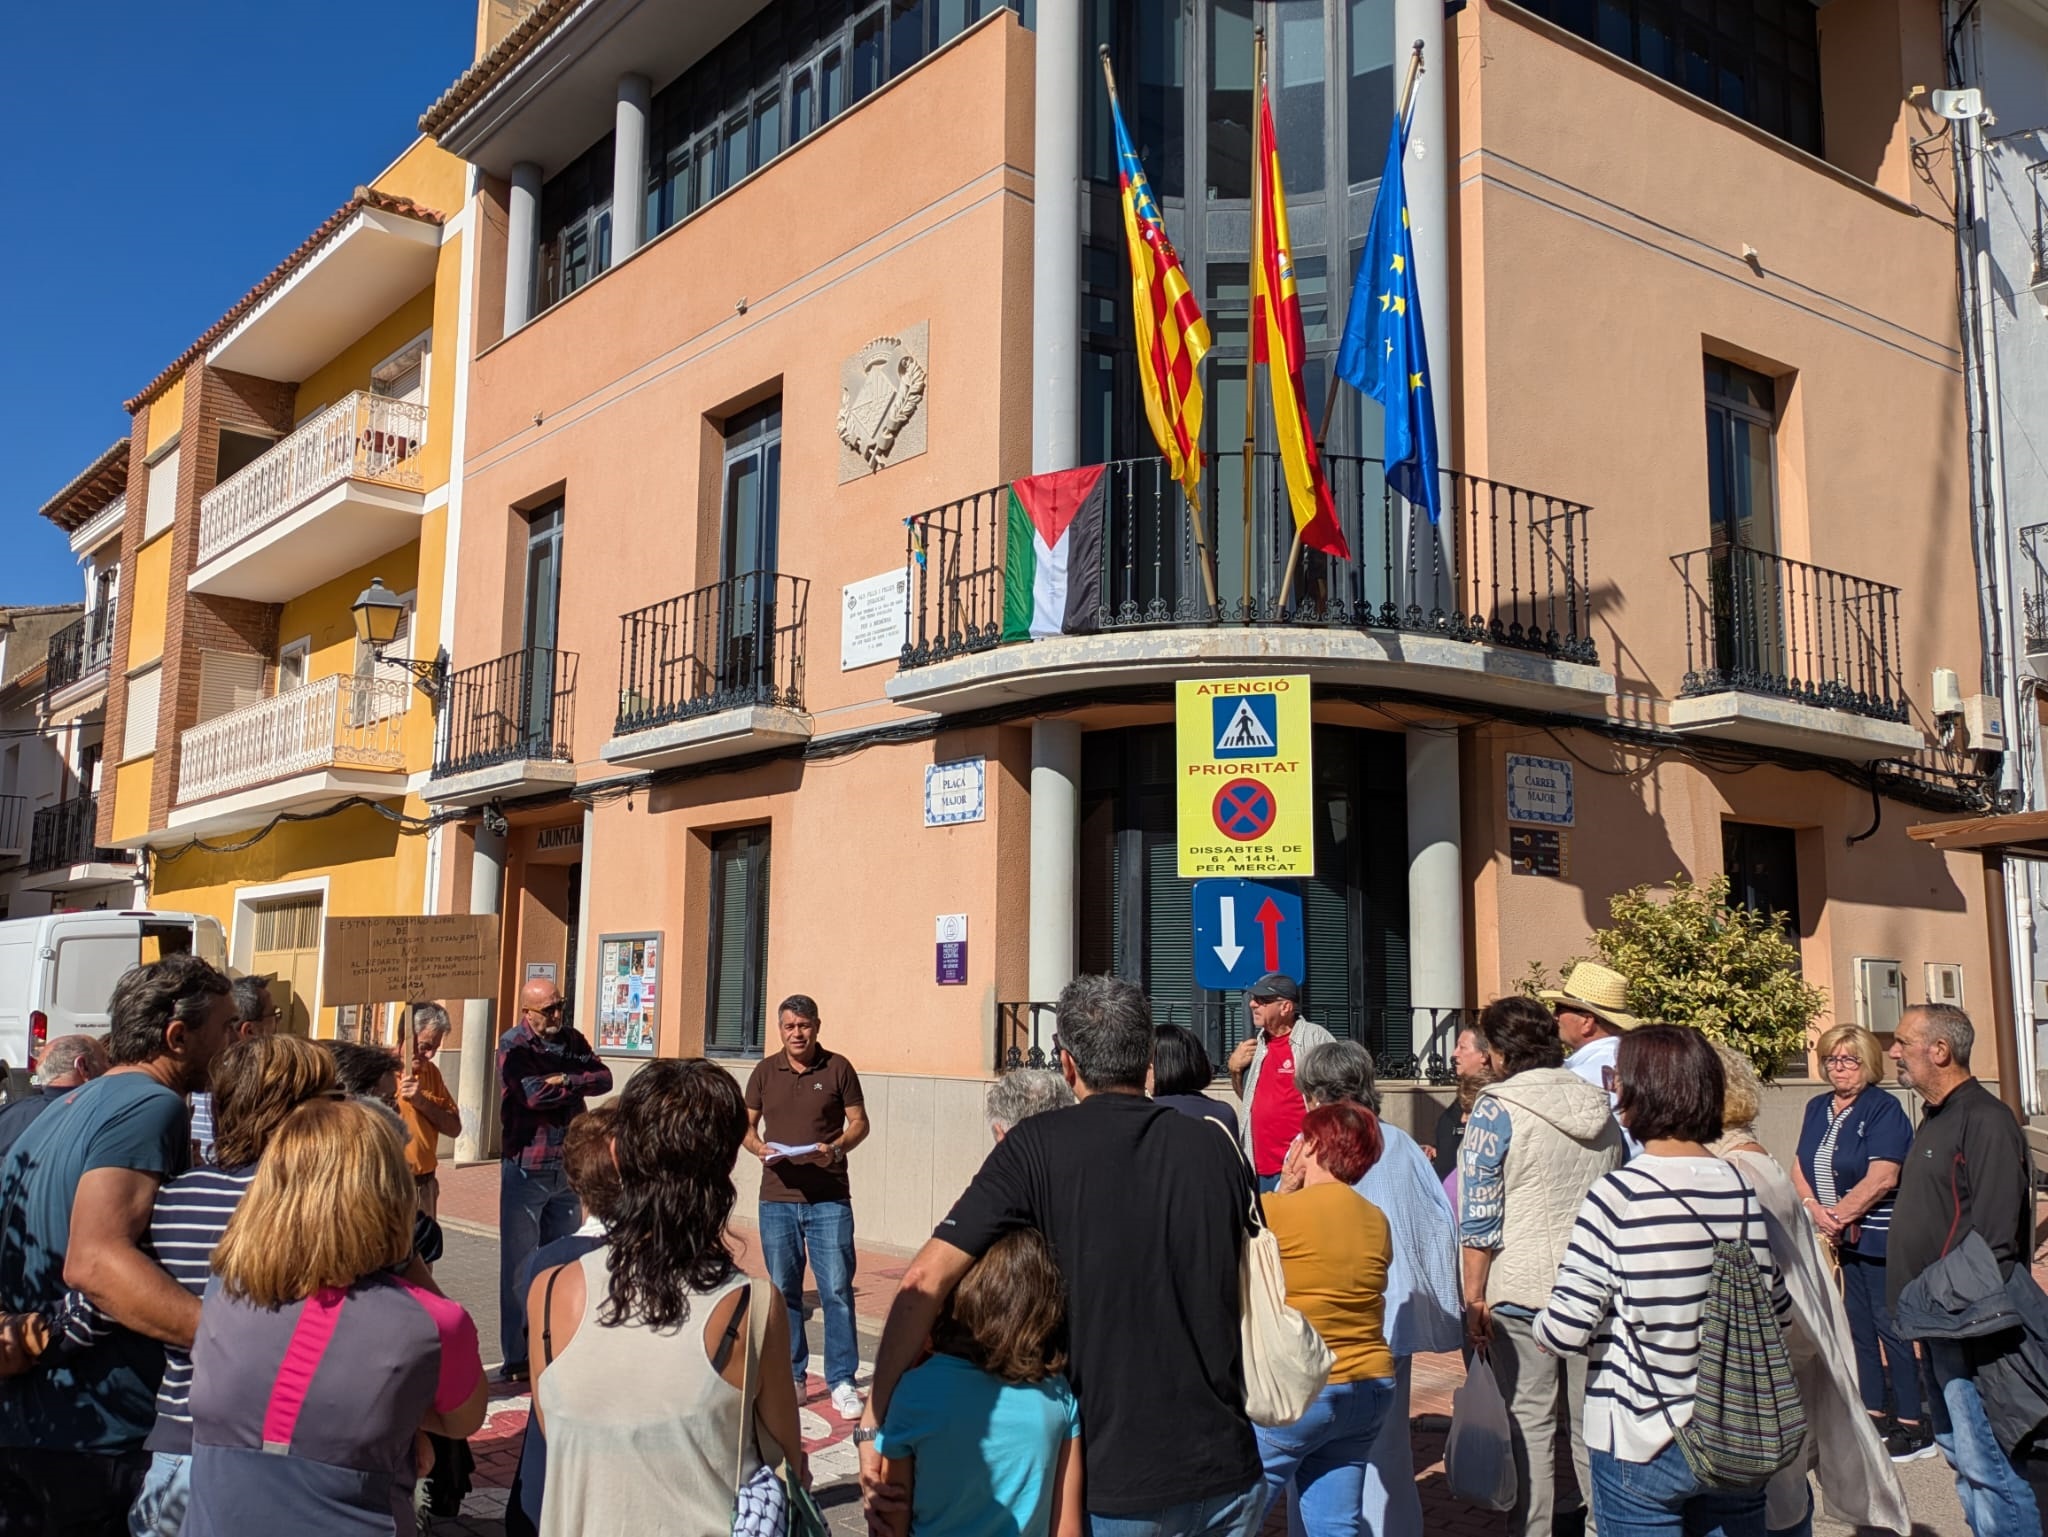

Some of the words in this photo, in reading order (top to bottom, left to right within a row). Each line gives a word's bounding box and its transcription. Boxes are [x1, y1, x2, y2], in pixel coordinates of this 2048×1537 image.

[1197, 679, 1290, 695] ATENCIÓ
[1188, 761, 1300, 776] PRIORITAT
[1525, 775, 1557, 789] CARRER
[1527, 791, 1556, 803] MAJOR
[1189, 846, 1274, 854] DISSABTES
[1282, 845, 1302, 853] DE
[1211, 855, 1219, 863] 6
[1227, 855, 1237, 863] A
[1234, 863, 1297, 872] MERCAT
[339, 919, 380, 930] ESTADO
[396, 926, 408, 936] DE
